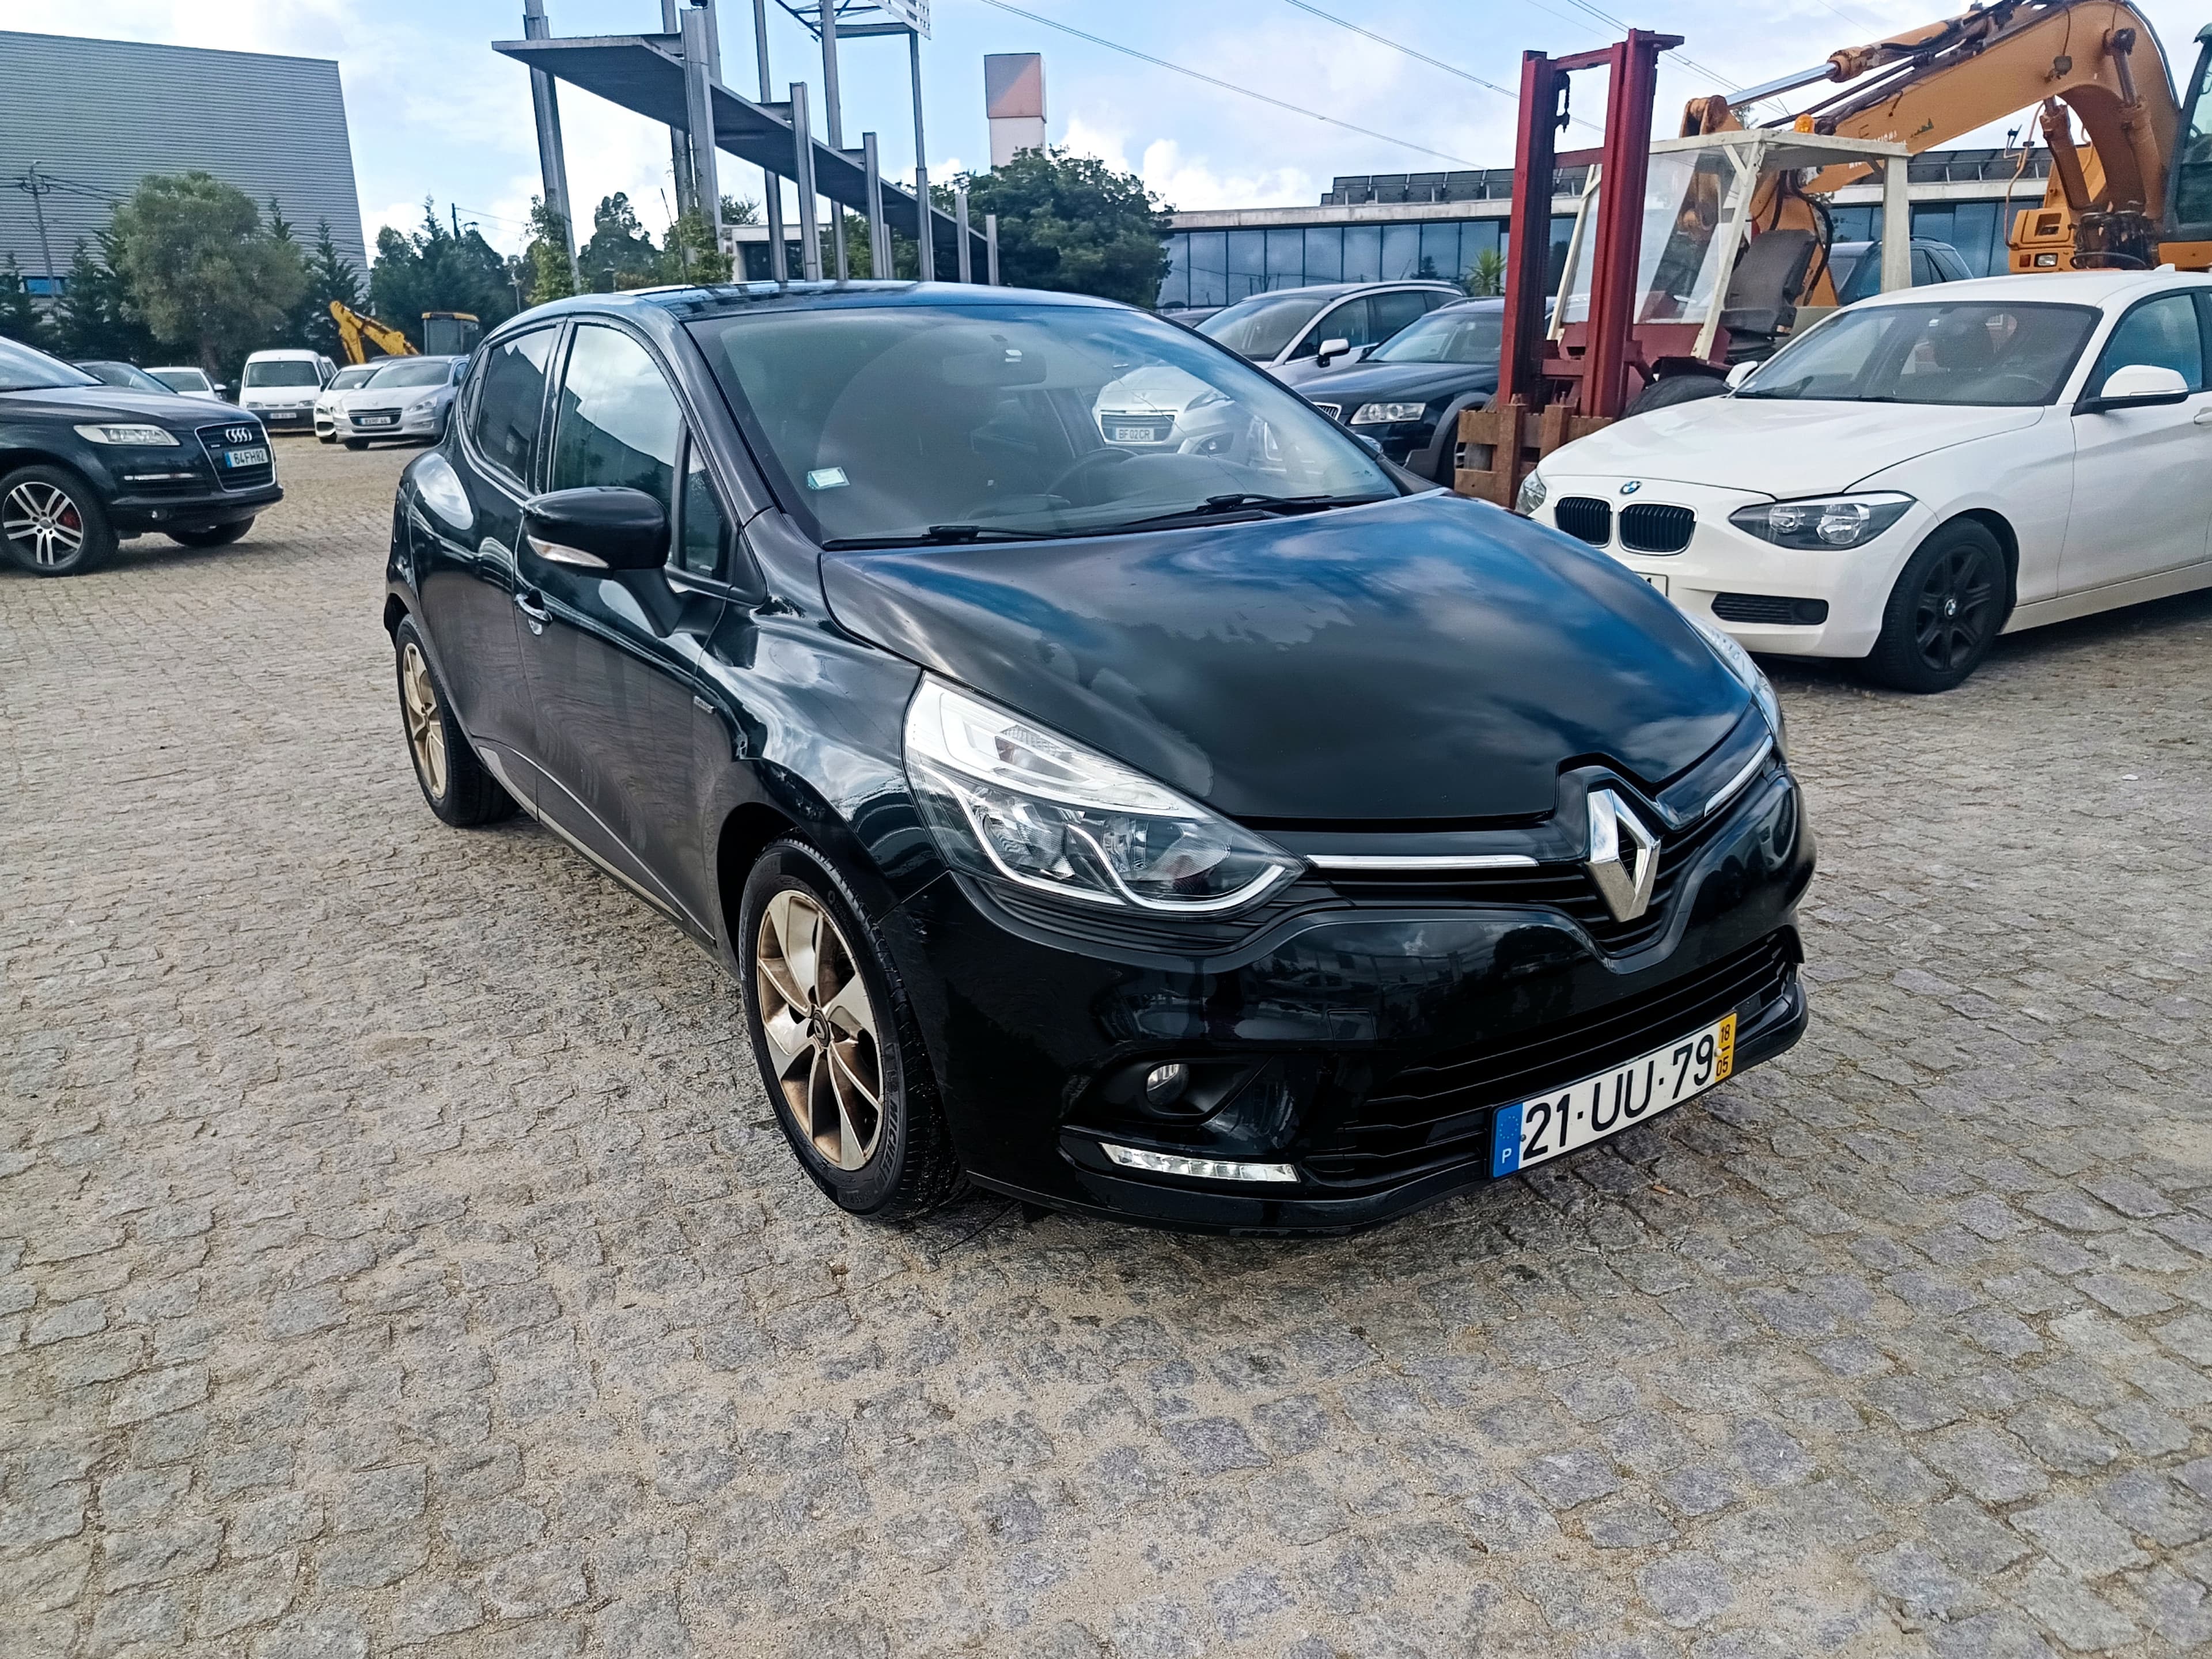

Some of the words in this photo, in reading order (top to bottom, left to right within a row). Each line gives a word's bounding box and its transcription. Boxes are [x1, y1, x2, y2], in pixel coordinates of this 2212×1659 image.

[1720, 1023, 1730, 1043] 18
[1715, 1055, 1729, 1077] 05
[1502, 1147, 1512, 1164] P
